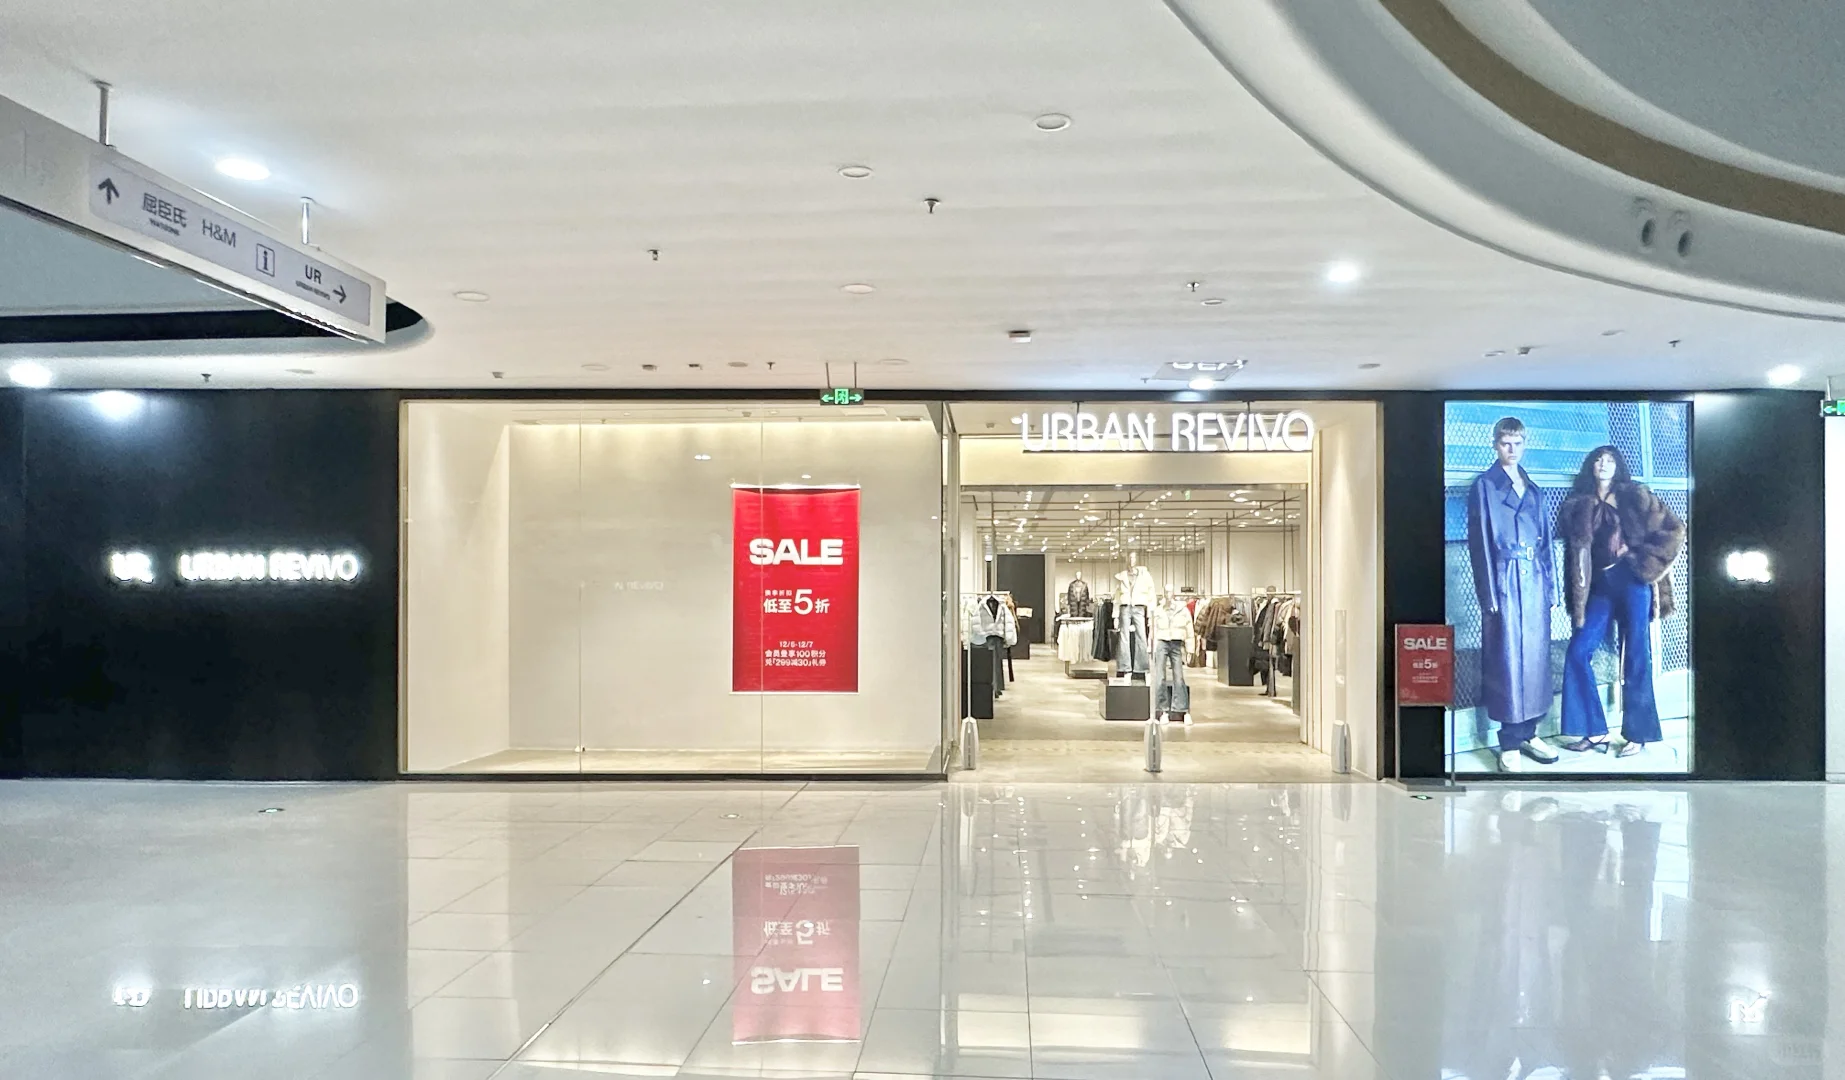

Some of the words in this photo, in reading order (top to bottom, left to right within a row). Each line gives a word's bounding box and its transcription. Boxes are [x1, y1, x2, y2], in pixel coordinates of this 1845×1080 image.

[142, 192, 187, 228] 屈臣氏
[202, 218, 236, 248] H&M
[305, 264, 322, 284] UR
[1021, 411, 1155, 452] URBAN
[1171, 410, 1315, 452] REVIVO
[268, 551, 359, 582] REVIVO
[749, 538, 844, 566] SALE
[763, 588, 830, 616] 低至5折
[1403, 637, 1448, 651] SALE
